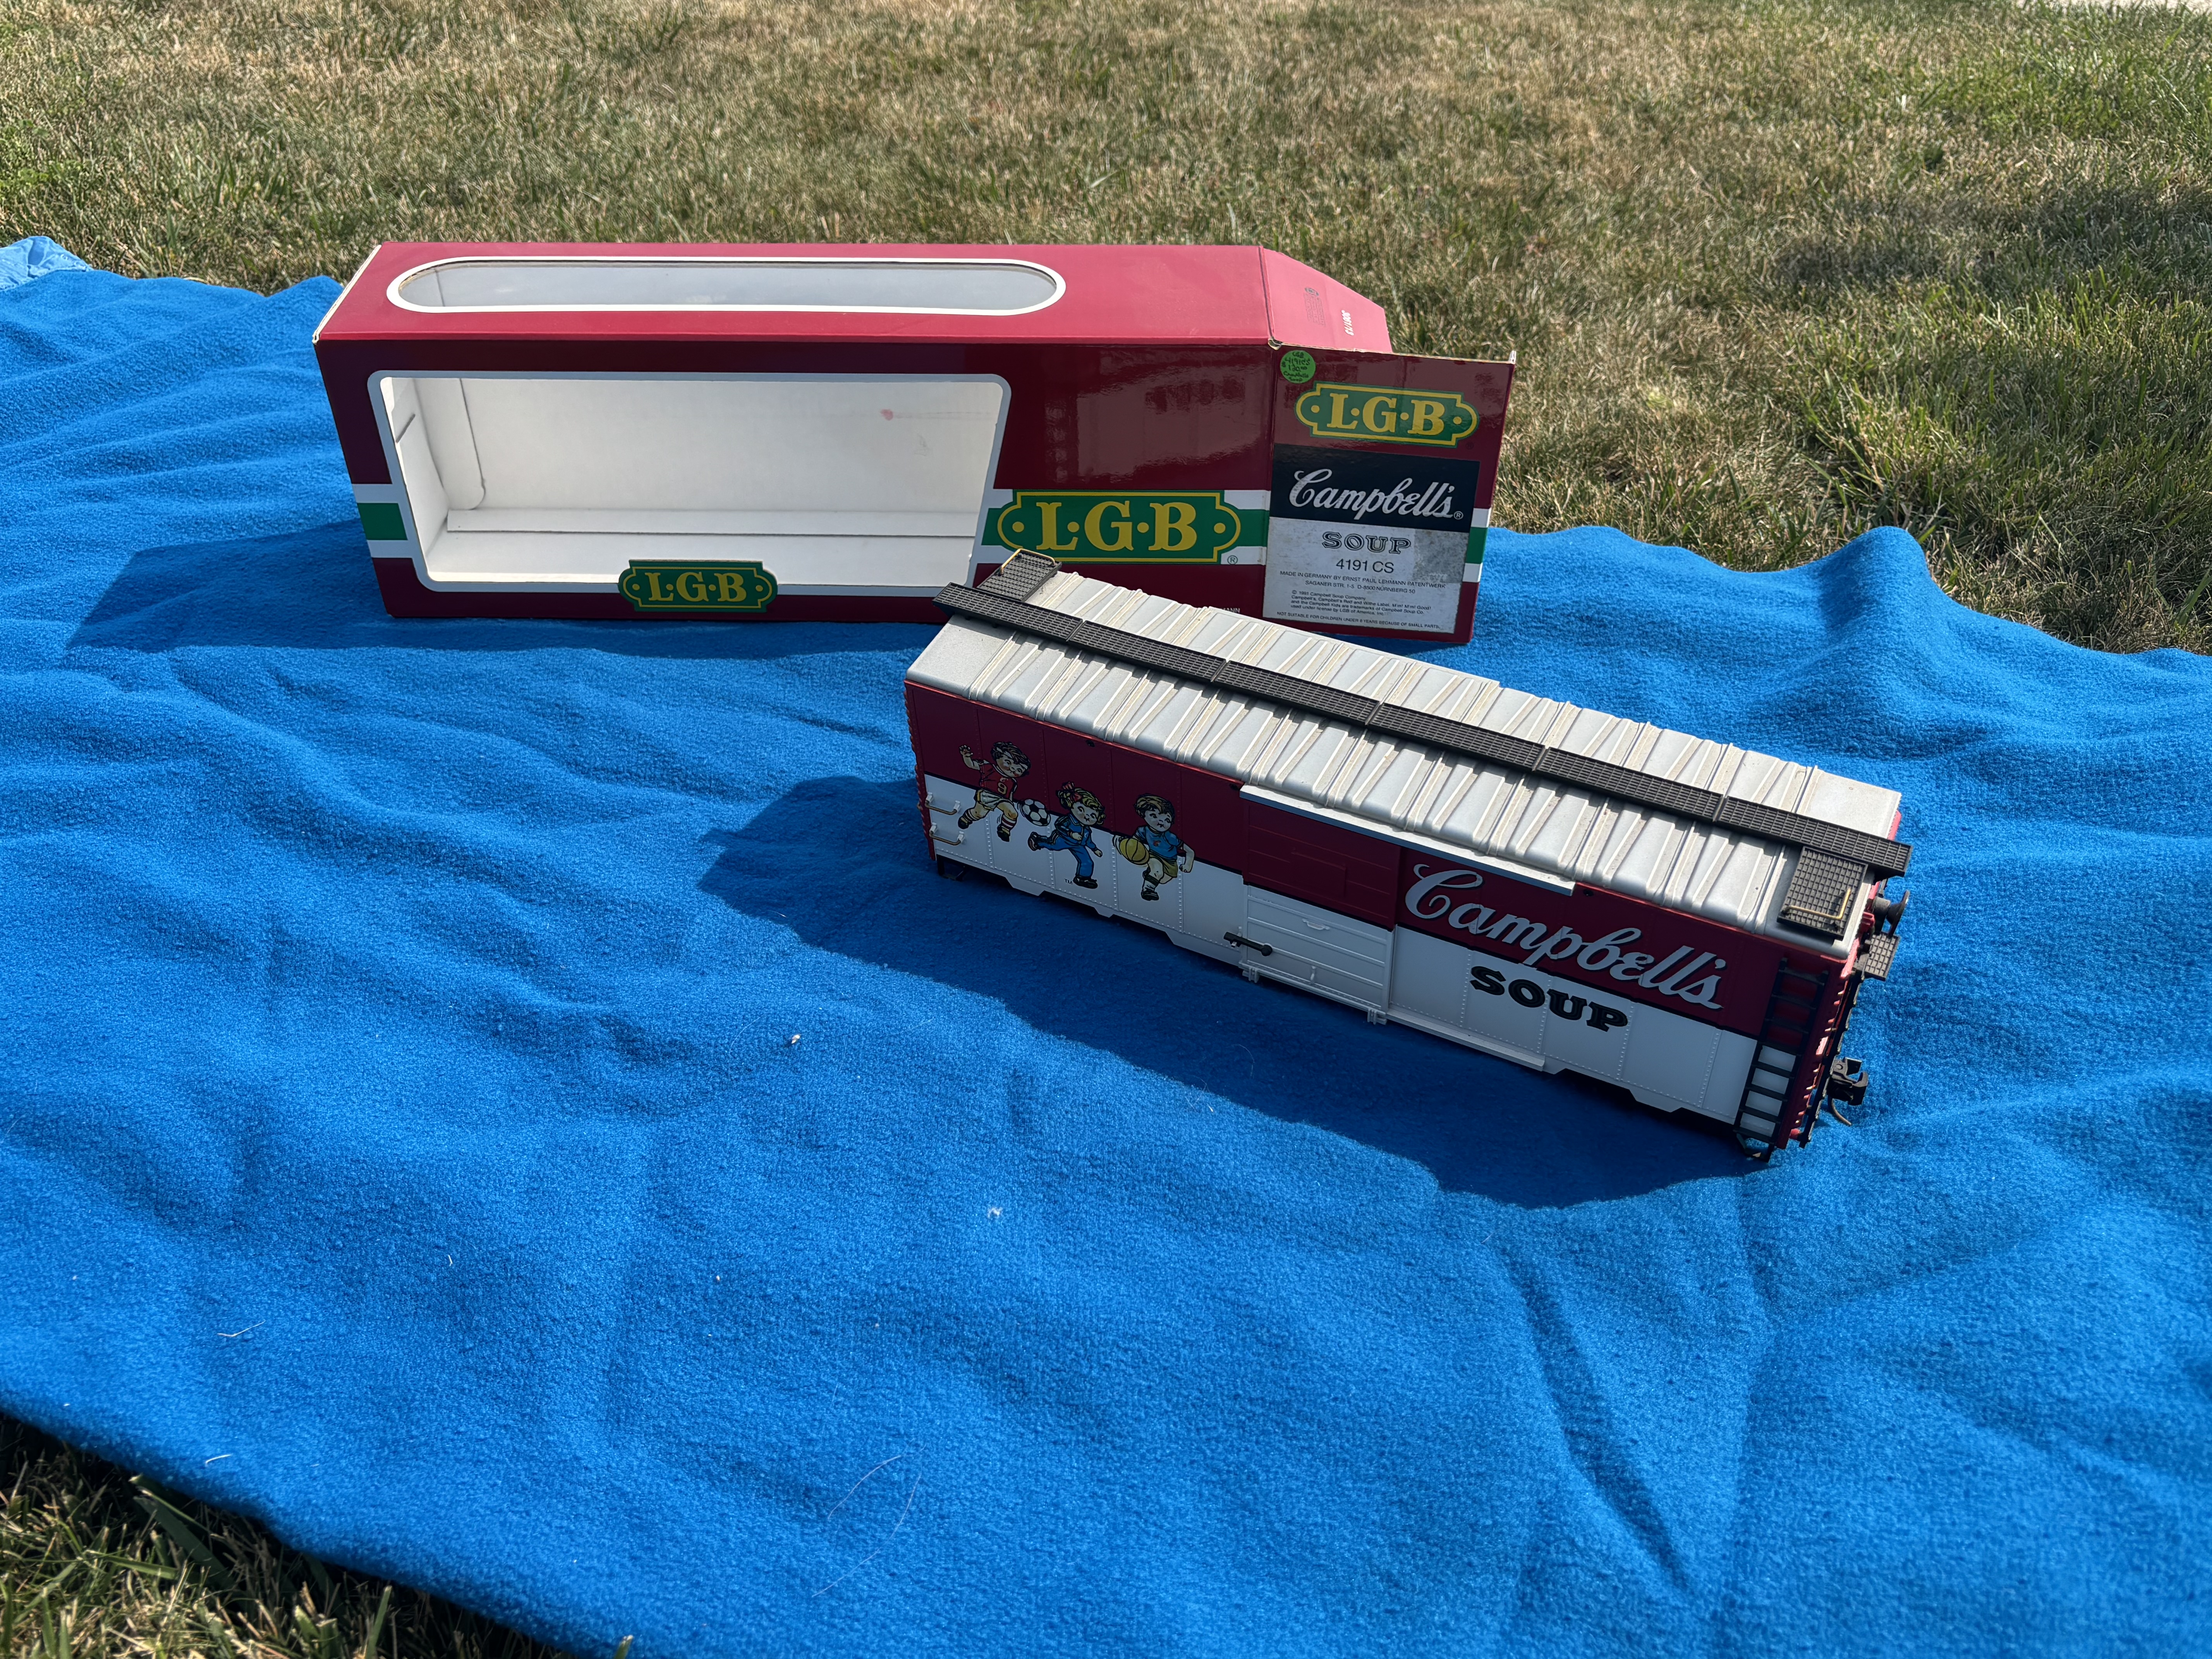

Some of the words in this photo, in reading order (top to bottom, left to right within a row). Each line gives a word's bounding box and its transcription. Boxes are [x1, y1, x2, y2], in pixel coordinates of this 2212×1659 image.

[1289, 469, 1454, 520] Campbell's
[1321, 531, 1411, 554] SOUP
[1336, 558, 1368, 572] 4191
[1372, 561, 1394, 574] CS
[1405, 864, 1726, 1009] Campbell's
[1470, 966, 1628, 1032] SOUP
